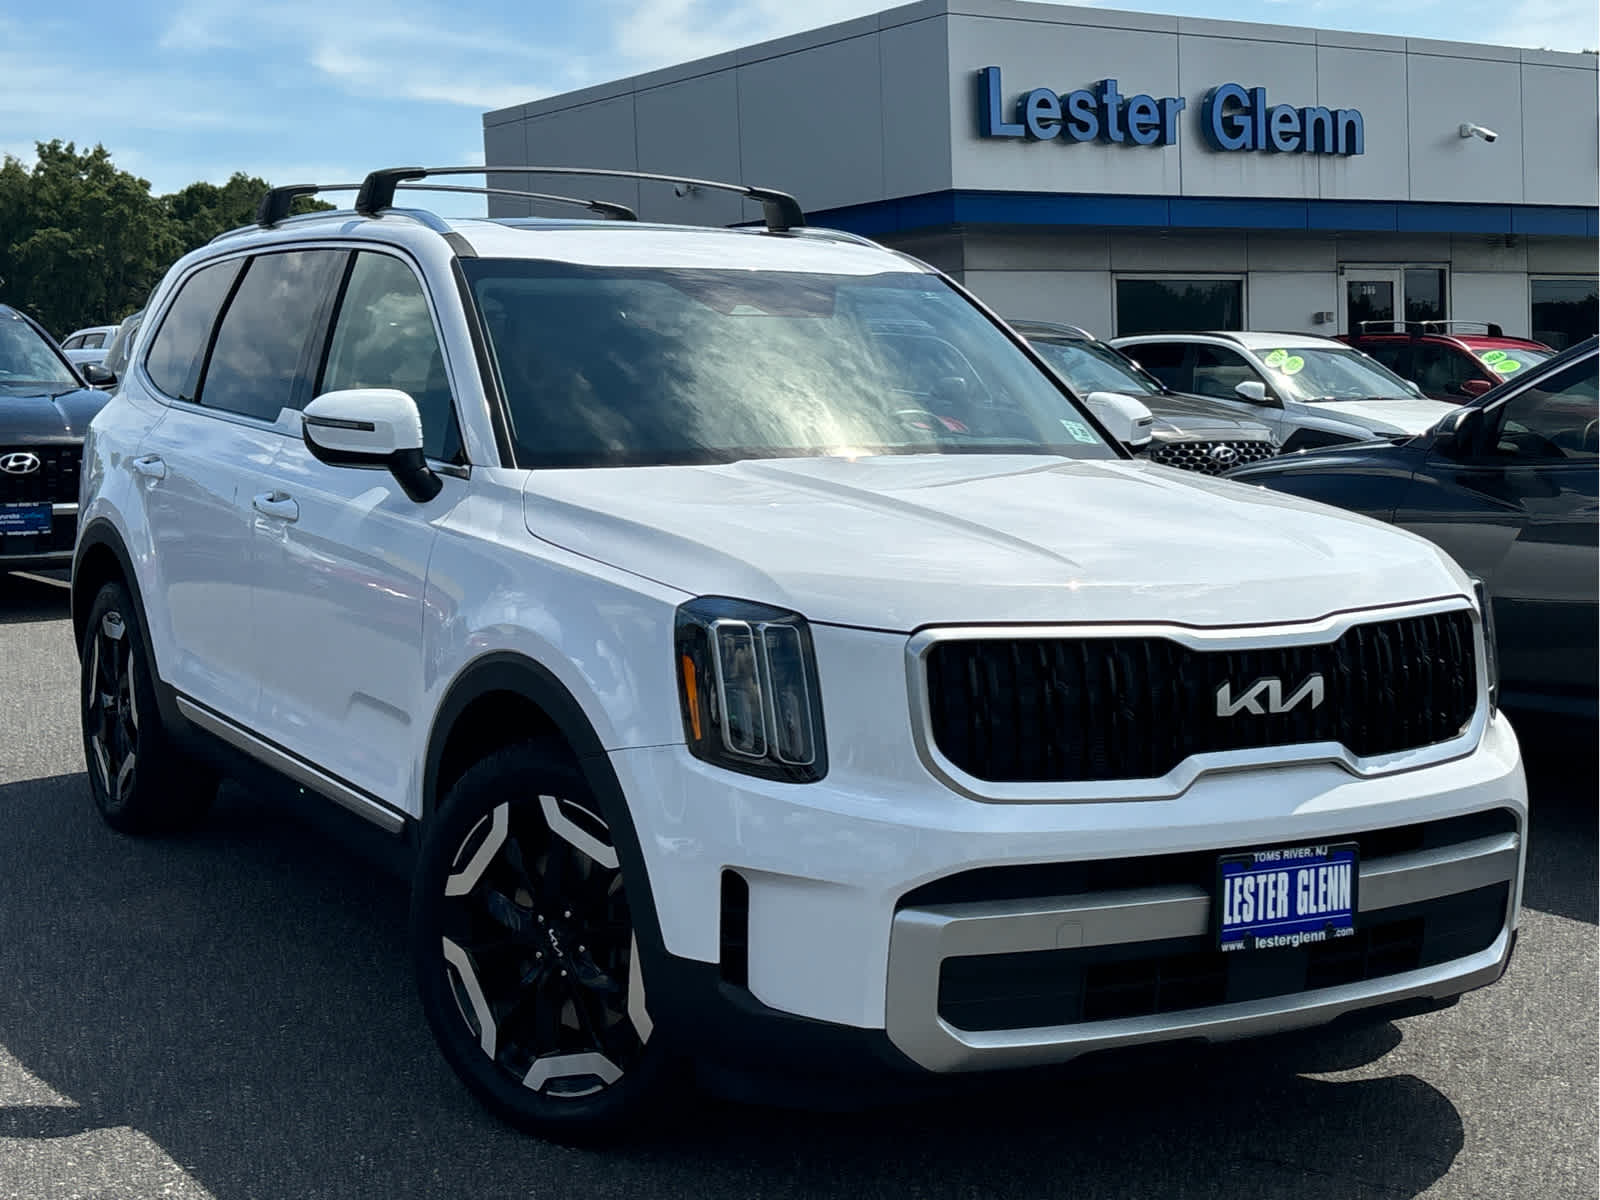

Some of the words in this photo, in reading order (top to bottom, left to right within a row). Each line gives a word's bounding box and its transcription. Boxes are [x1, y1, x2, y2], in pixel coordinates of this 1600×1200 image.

[977, 66, 1185, 147] Lester
[1202, 83, 1365, 156] Glenn
[1216, 675, 1324, 717] KIA
[1254, 852, 1281, 863] TOMS
[1316, 845, 1328, 856] NJ
[1223, 871, 1289, 926] LESTER
[1297, 863, 1351, 916] GLENN
[1255, 930, 1326, 949] lesterglenn
